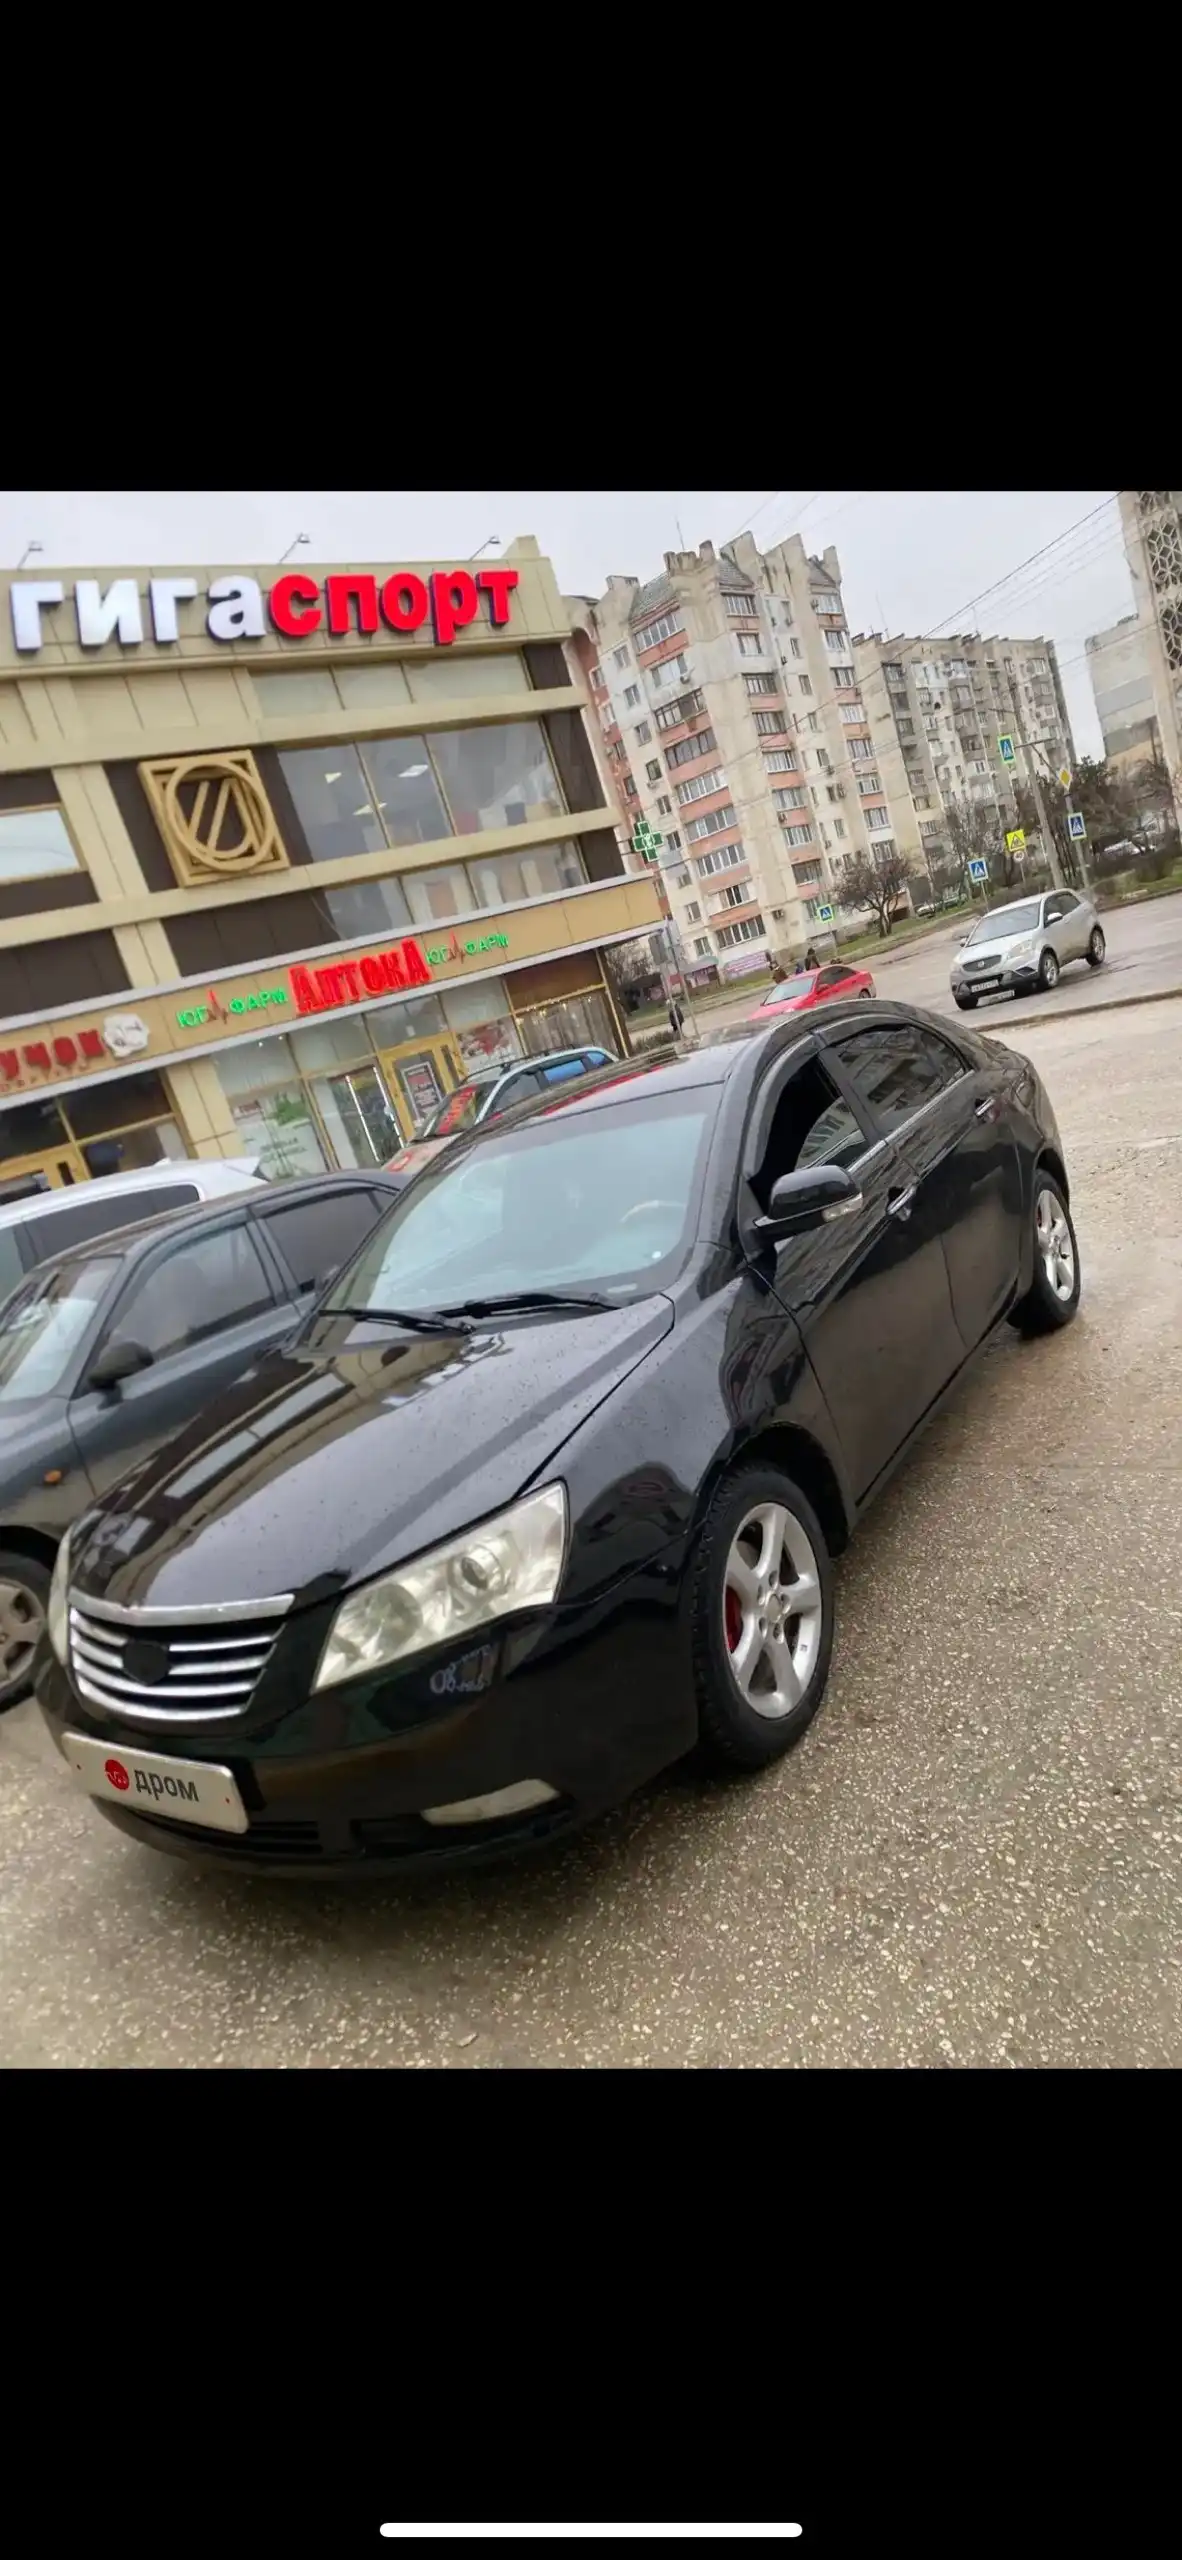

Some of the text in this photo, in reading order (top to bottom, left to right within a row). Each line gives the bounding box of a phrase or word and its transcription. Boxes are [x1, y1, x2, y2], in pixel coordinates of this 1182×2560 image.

[10, 570, 518, 652] гигаспорт
[465, 934, 509, 956] ФАРМ
[230, 988, 287, 1015] ФАРМ
